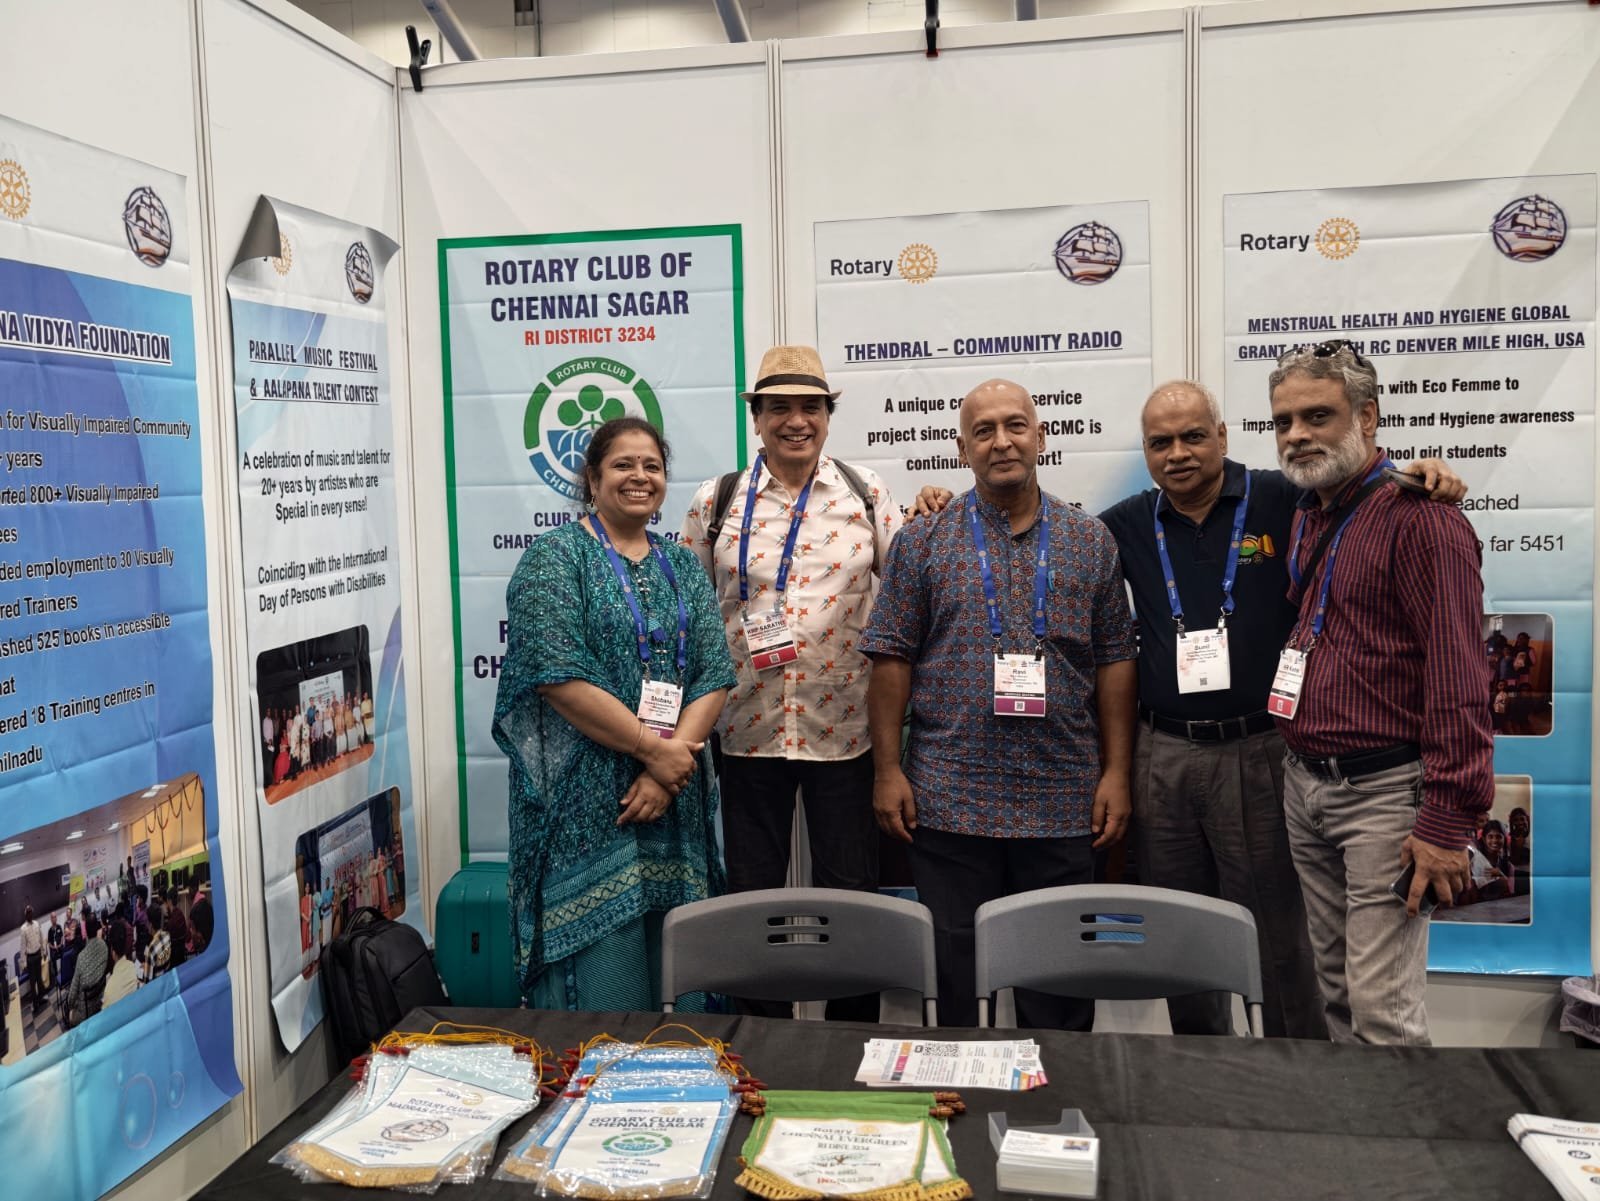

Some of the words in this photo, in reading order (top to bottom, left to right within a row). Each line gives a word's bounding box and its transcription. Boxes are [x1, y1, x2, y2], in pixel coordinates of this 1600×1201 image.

[1240, 233, 1310, 252] Rotary
[485, 258, 579, 285] ROTARY
[587, 254, 651, 281] CLUB
[660, 252, 692, 277] OF
[831, 258, 893, 277] Rotary
[491, 294, 598, 322] CHENNAI
[607, 290, 689, 317] SAGAR
[1248, 316, 1336, 332] MENSTRUAL
[1341, 313, 1398, 329] HEALTH
[1402, 311, 1435, 326] AND
[1440, 308, 1506, 325] HYGIENE
[1511, 305, 1570, 321] GLOBAL
[24, 316, 75, 347] VIDYA
[80, 325, 170, 360] FOUNDATION
[525, 330, 540, 345] RI
[545, 328, 613, 345] DISTRICT
[618, 326, 656, 342] 3234
[845, 341, 932, 361] THENDRAL
[954, 333, 1062, 355] COMMUNITY
[1068, 330, 1122, 349] RADIO
[1370, 339, 1390, 355] RC
[1396, 337, 1457, 353] DENVER
[1463, 335, 1500, 350] MILE
[1506, 334, 1549, 350] HIGH,
[1555, 332, 1585, 347] USA
[249, 340, 297, 363] PARALLEL
[304, 347, 332, 366] MUSIC
[339, 350, 378, 371] FESTIVAL
[556, 361, 597, 379] ROTARY
[601, 362, 627, 378] CLUB
[250, 377, 257, 397] &
[312, 383, 342, 401] TALENT
[344, 384, 378, 403] CONTEST
[1388, 380, 1418, 394] with
[1422, 380, 1448, 393] Eco
[1452, 378, 1501, 392] Femme
[1505, 377, 1519, 390] to
[885, 398, 894, 413] A
[898, 397, 945, 415] unique
[1032, 390, 1082, 406] service
[7, 411, 25, 429] for
[29, 412, 80, 435] Visually
[84, 416, 130, 435] Impaired
[133, 418, 191, 438] Community
[1410, 412, 1435, 427] and
[1440, 410, 1495, 428] Hygiene
[1500, 409, 1575, 424] awareness
[868, 427, 916, 446] project
[920, 425, 957, 442] since
[1090, 419, 1102, 434] is
[7, 453, 43, 471] years
[243, 451, 251, 470] A
[253, 451, 301, 470] celebration
[304, 450, 314, 467] of
[316, 451, 339, 467] music
[341, 450, 355, 466] and
[356, 449, 379, 465] talent
[380, 449, 391, 465] for
[1447, 444, 1507, 459] students
[30, 486, 62, 503] 800+
[66, 485, 111, 504] Visually
[115, 484, 159, 504] Impaired
[261, 478, 277, 496] 20+
[279, 479, 303, 498] years
[305, 476, 316, 496] by
[319, 475, 348, 491] artistes
[349, 473, 364, 488] who
[366, 475, 379, 488] are
[275, 501, 308, 524] Special
[310, 501, 319, 517] in
[321, 502, 343, 518] every
[534, 512, 571, 527] CLUB
[1489, 535, 1515, 551] far
[1520, 535, 1565, 551] 5451
[26, 557, 103, 580] employment
[107, 554, 117, 569] to
[121, 550, 132, 567] 30
[134, 547, 174, 566] Visually
[258, 561, 306, 584] Coinciding
[308, 557, 327, 575] with
[328, 554, 341, 571] the
[342, 546, 387, 569] International
[24, 595, 78, 615] Trainers
[259, 593, 277, 614] Day
[280, 589, 289, 608] of
[290, 583, 327, 605] Persons
[328, 579, 345, 597] with
[346, 571, 386, 593] Disabilities
[37, 630, 60, 650] 525
[64, 624, 101, 646] books
[104, 621, 115, 639] in
[117, 613, 171, 636] accessible
[31, 706, 46, 725] 18
[49, 696, 101, 721] Training
[104, 686, 142, 708] centres
[144, 681, 155, 697] in
